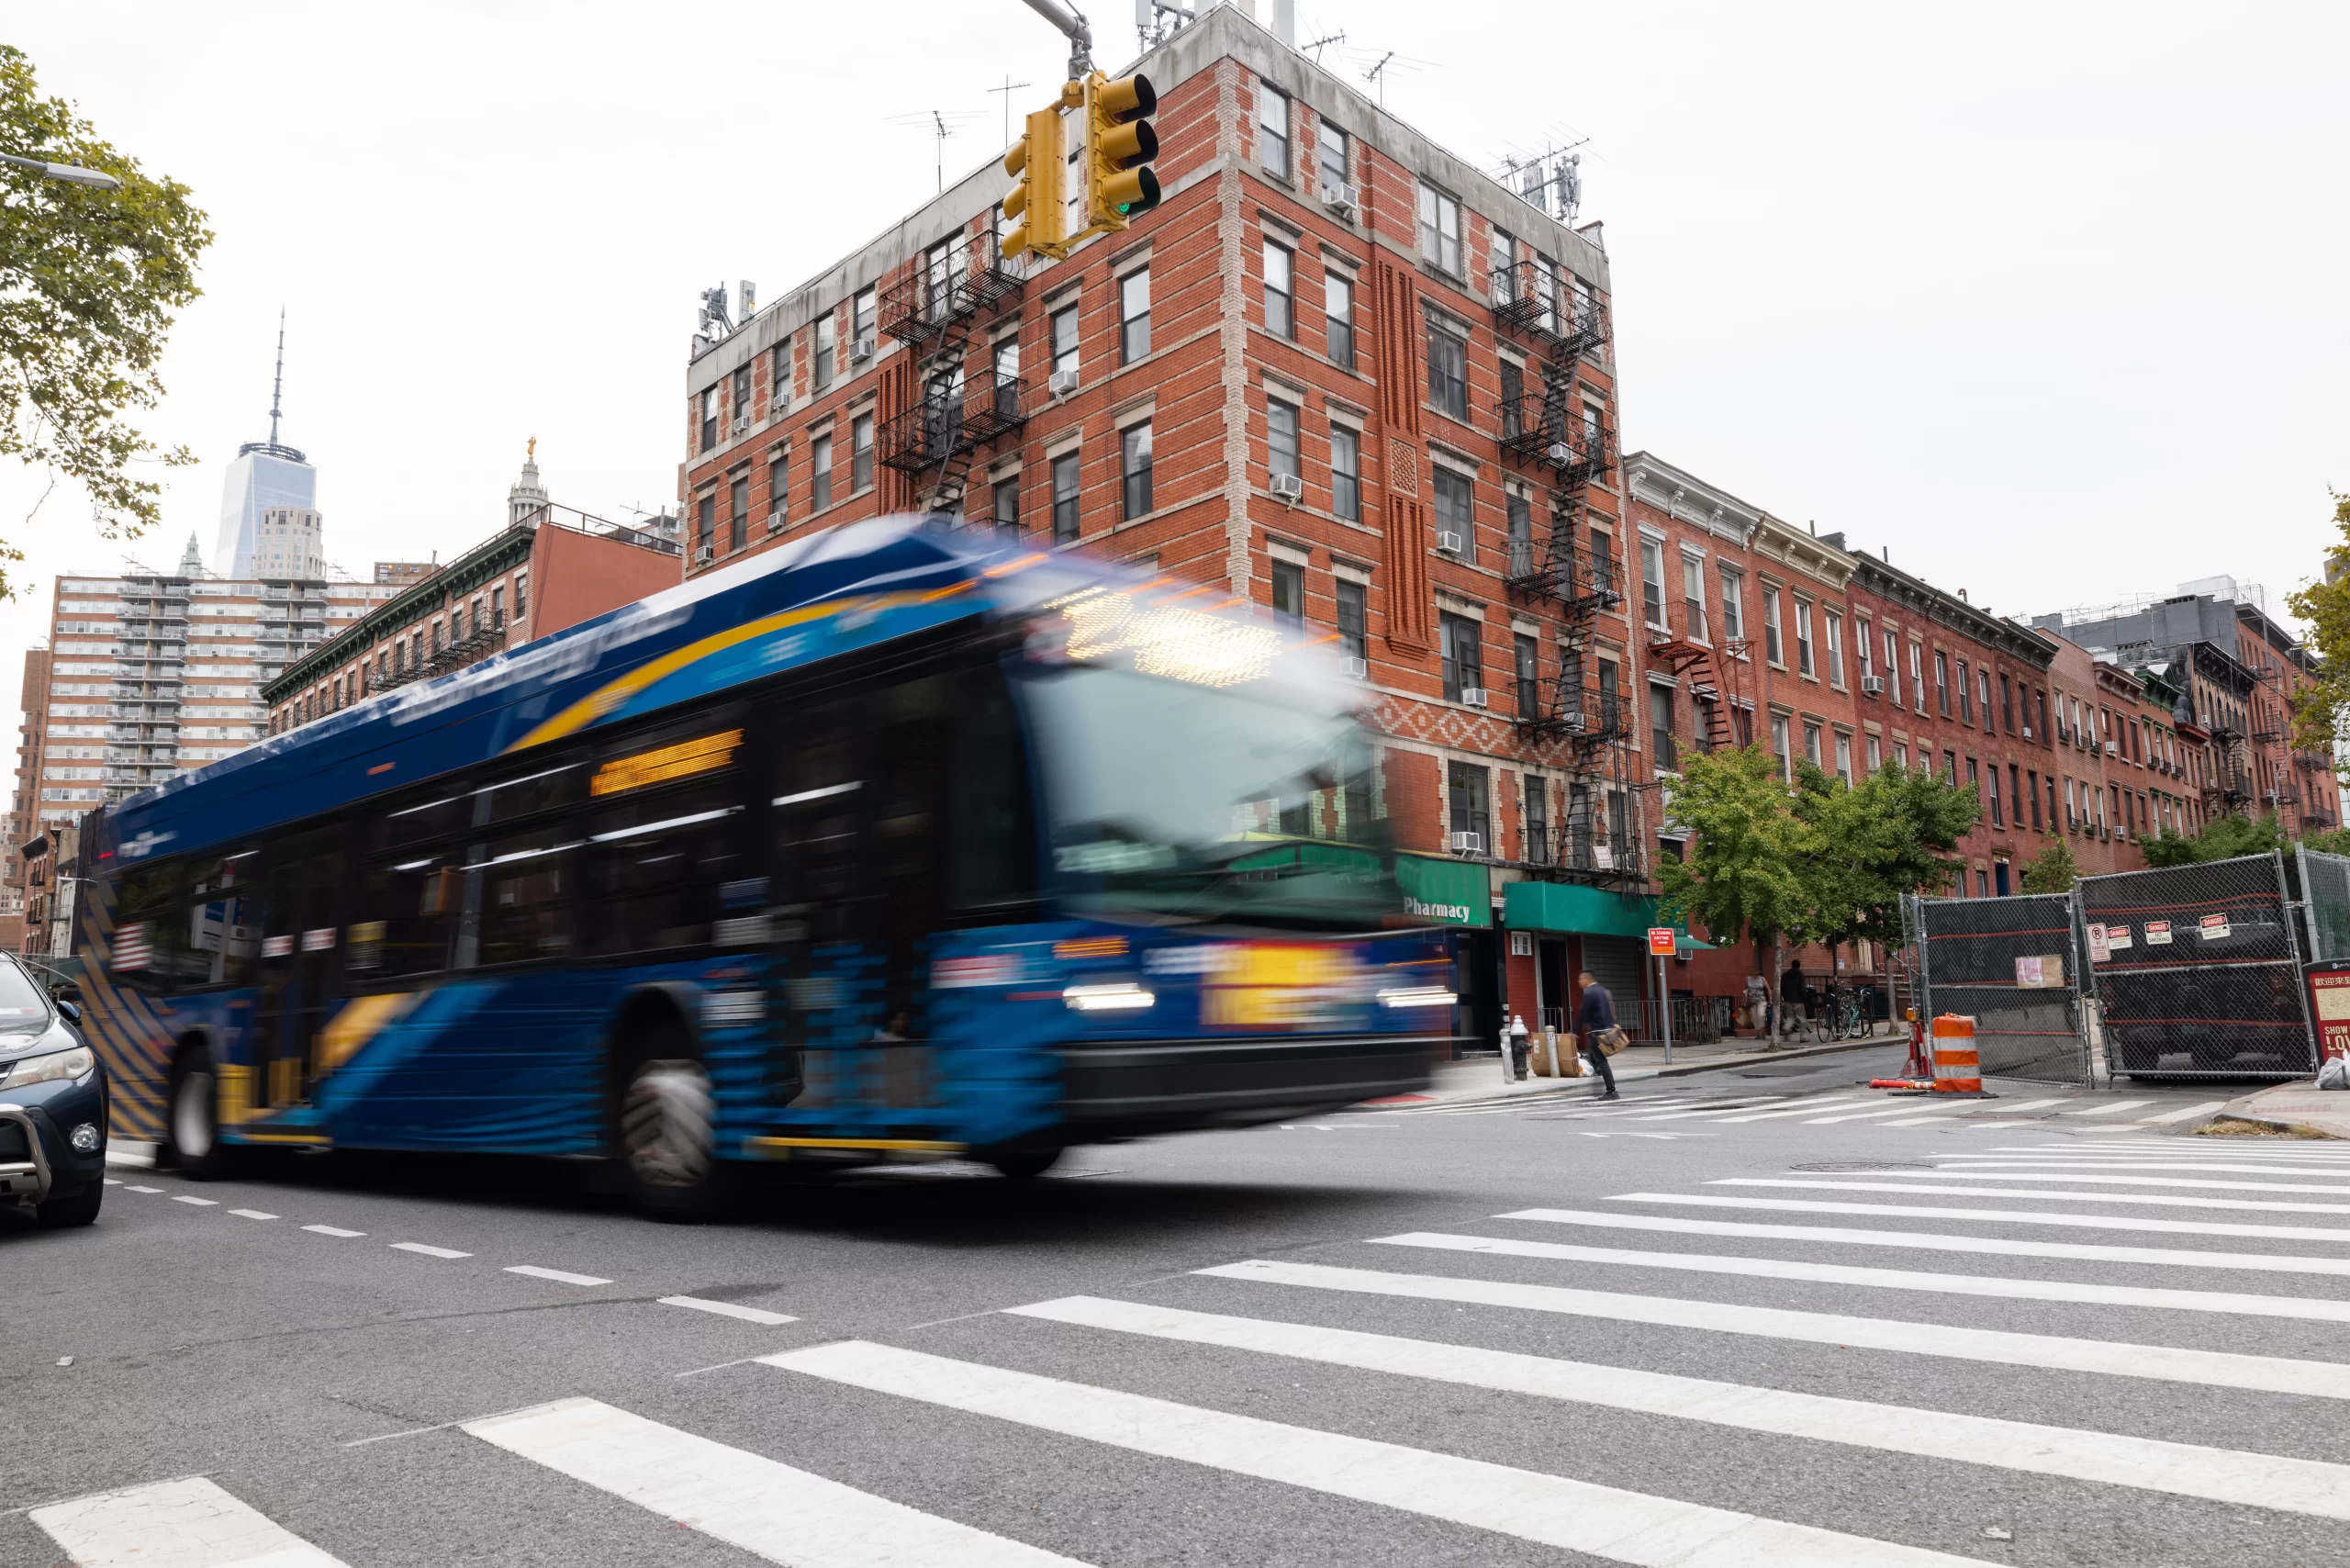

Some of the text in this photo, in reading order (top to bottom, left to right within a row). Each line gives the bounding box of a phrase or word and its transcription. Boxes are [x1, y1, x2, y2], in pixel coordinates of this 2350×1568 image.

[1404, 896, 1470, 923] Pharmacy
[2204, 917, 2223, 925] DANGER
[2324, 1025, 2348, 1035] SHOW
